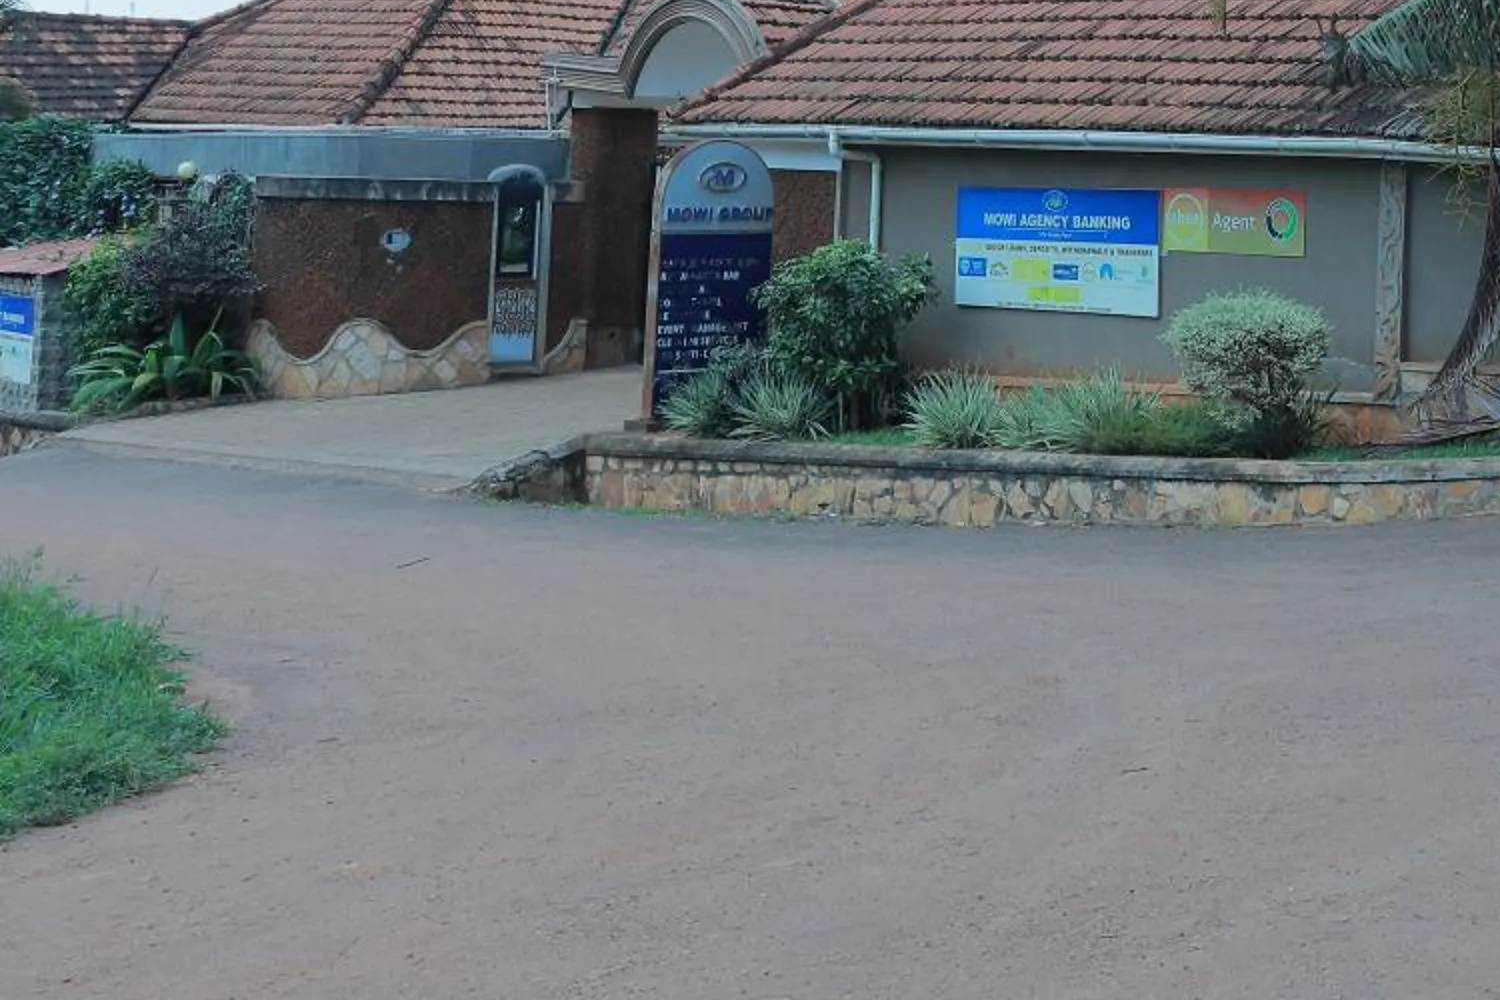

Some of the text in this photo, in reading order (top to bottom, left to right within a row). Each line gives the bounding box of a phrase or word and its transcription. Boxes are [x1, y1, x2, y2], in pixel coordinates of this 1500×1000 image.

[667, 206, 774, 222] MOWI GROUP
[983, 212, 1131, 230] MOWI AGENCY BANKING
[1213, 212, 1255, 232] Agent
